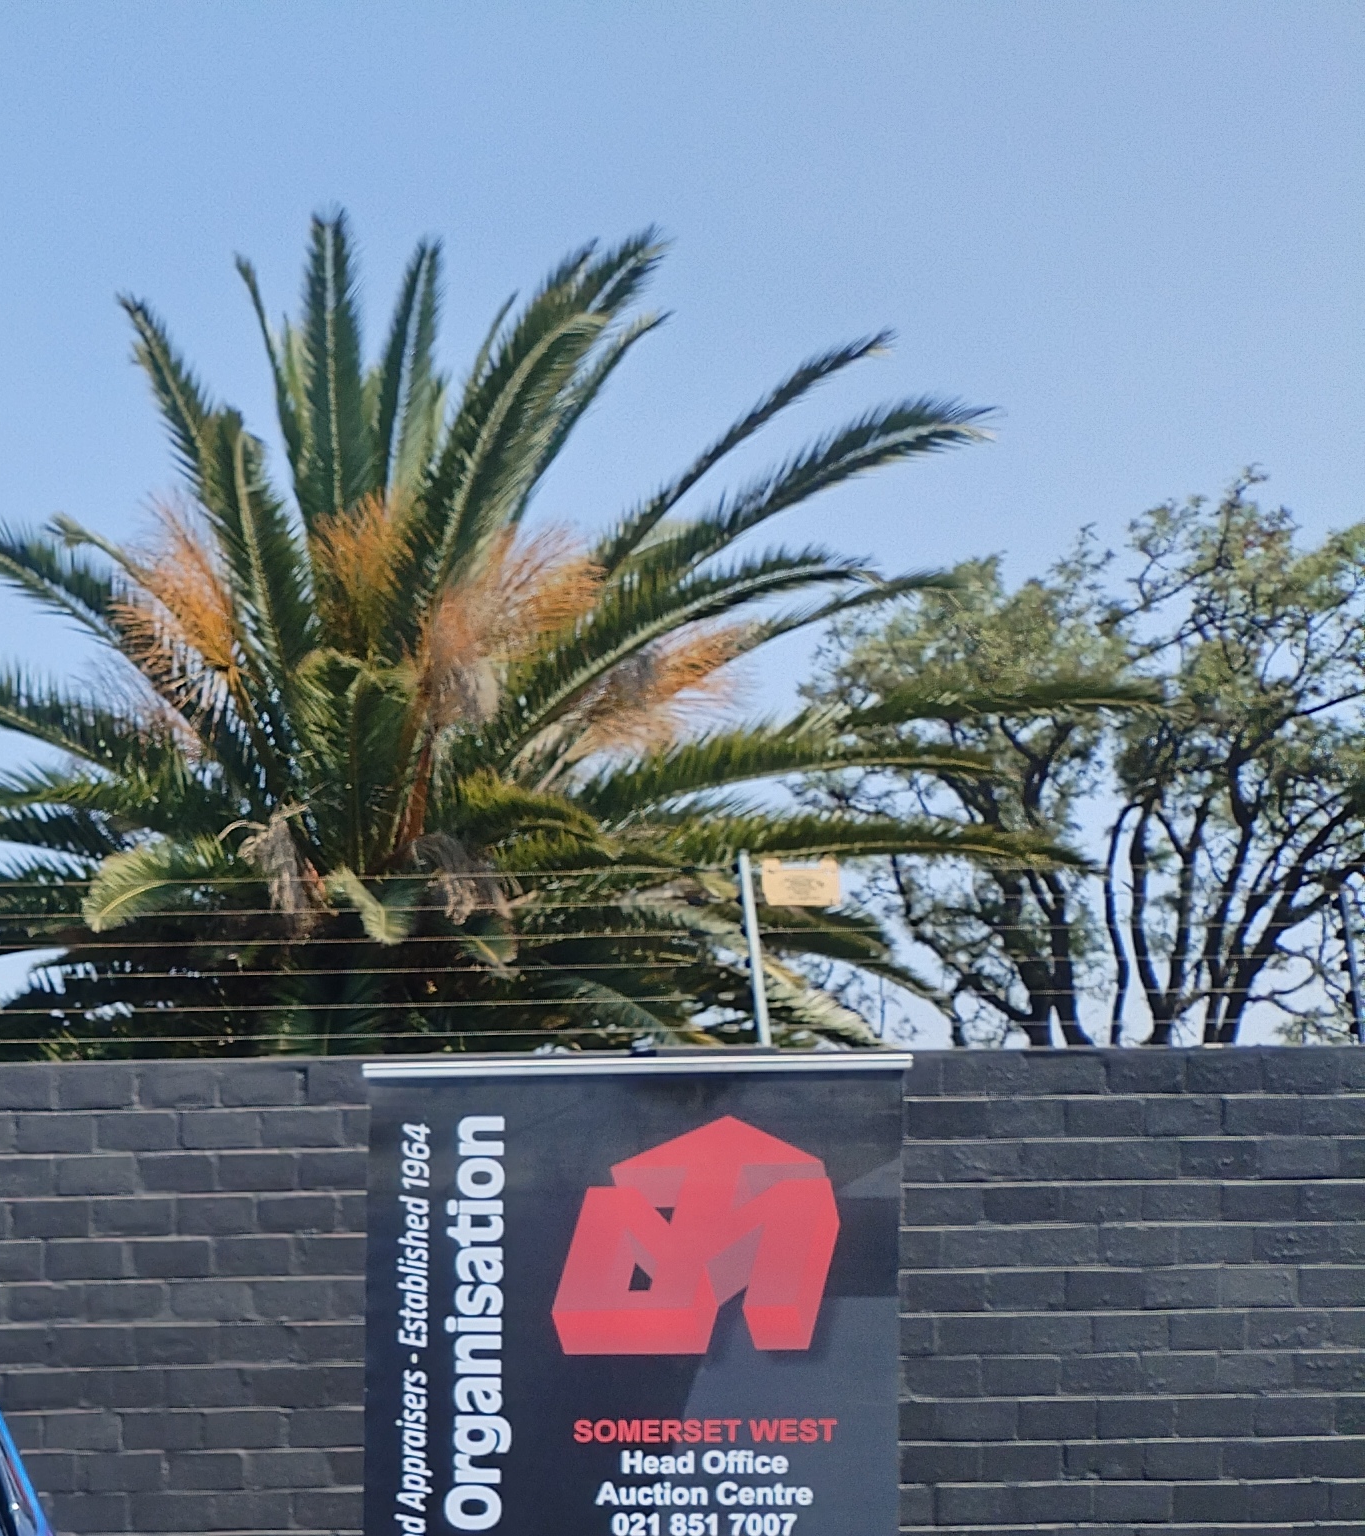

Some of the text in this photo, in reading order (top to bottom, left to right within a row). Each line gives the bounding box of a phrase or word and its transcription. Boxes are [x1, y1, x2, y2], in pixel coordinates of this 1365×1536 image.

[401, 1123, 431, 1190] 1964
[397, 1194, 430, 1348] Established
[444, 1115, 512, 1531] Organisation
[395, 1368, 433, 1508] Appraisers
[573, 1418, 838, 1444] SOMERSET WEST
[621, 1449, 789, 1475] Head Office
[595, 1481, 814, 1506] Auction Centre
[611, 1512, 660, 1536] 021
